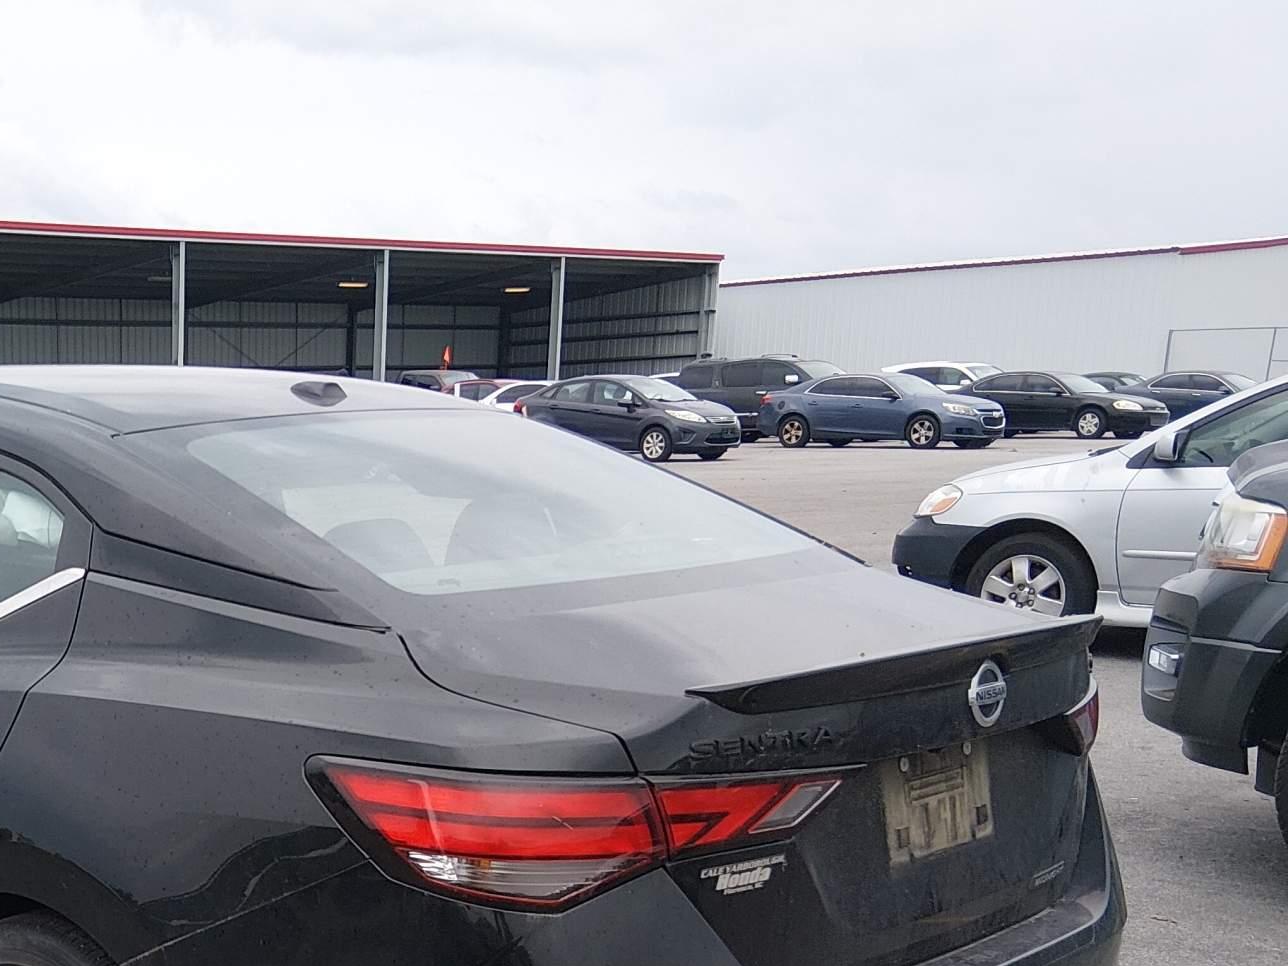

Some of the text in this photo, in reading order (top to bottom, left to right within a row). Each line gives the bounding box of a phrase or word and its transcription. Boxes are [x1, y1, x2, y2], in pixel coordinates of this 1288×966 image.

[975, 686, 1005, 702] NISSAN
[689, 726, 834, 759] SENTRA
[715, 866, 772, 891] Honda
